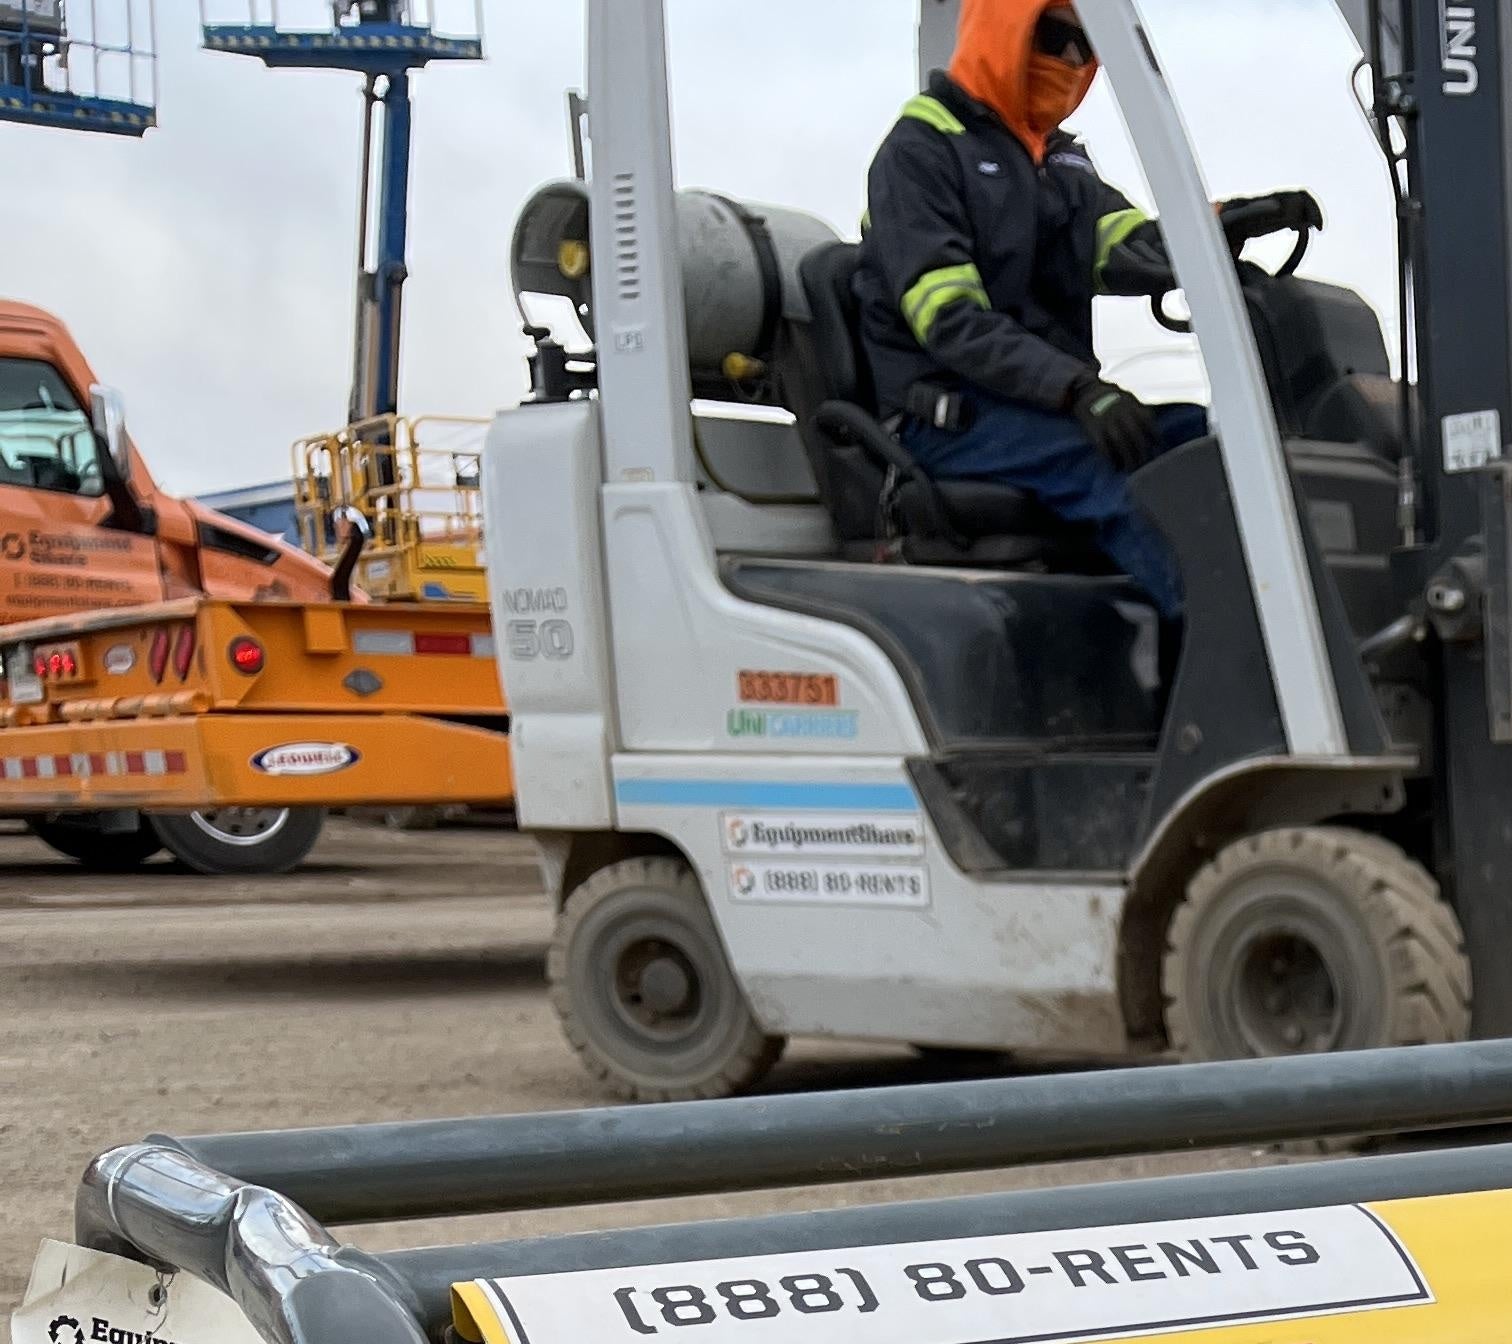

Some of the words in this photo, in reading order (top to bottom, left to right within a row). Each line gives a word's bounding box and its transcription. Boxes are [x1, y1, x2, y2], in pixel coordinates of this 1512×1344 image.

[1441, 7, 1479, 94] UNI
[506, 619, 575, 661] 50
[613, 1267, 880, 1334] (888)
[903, 1230, 1320, 1303] 80-RENTS
